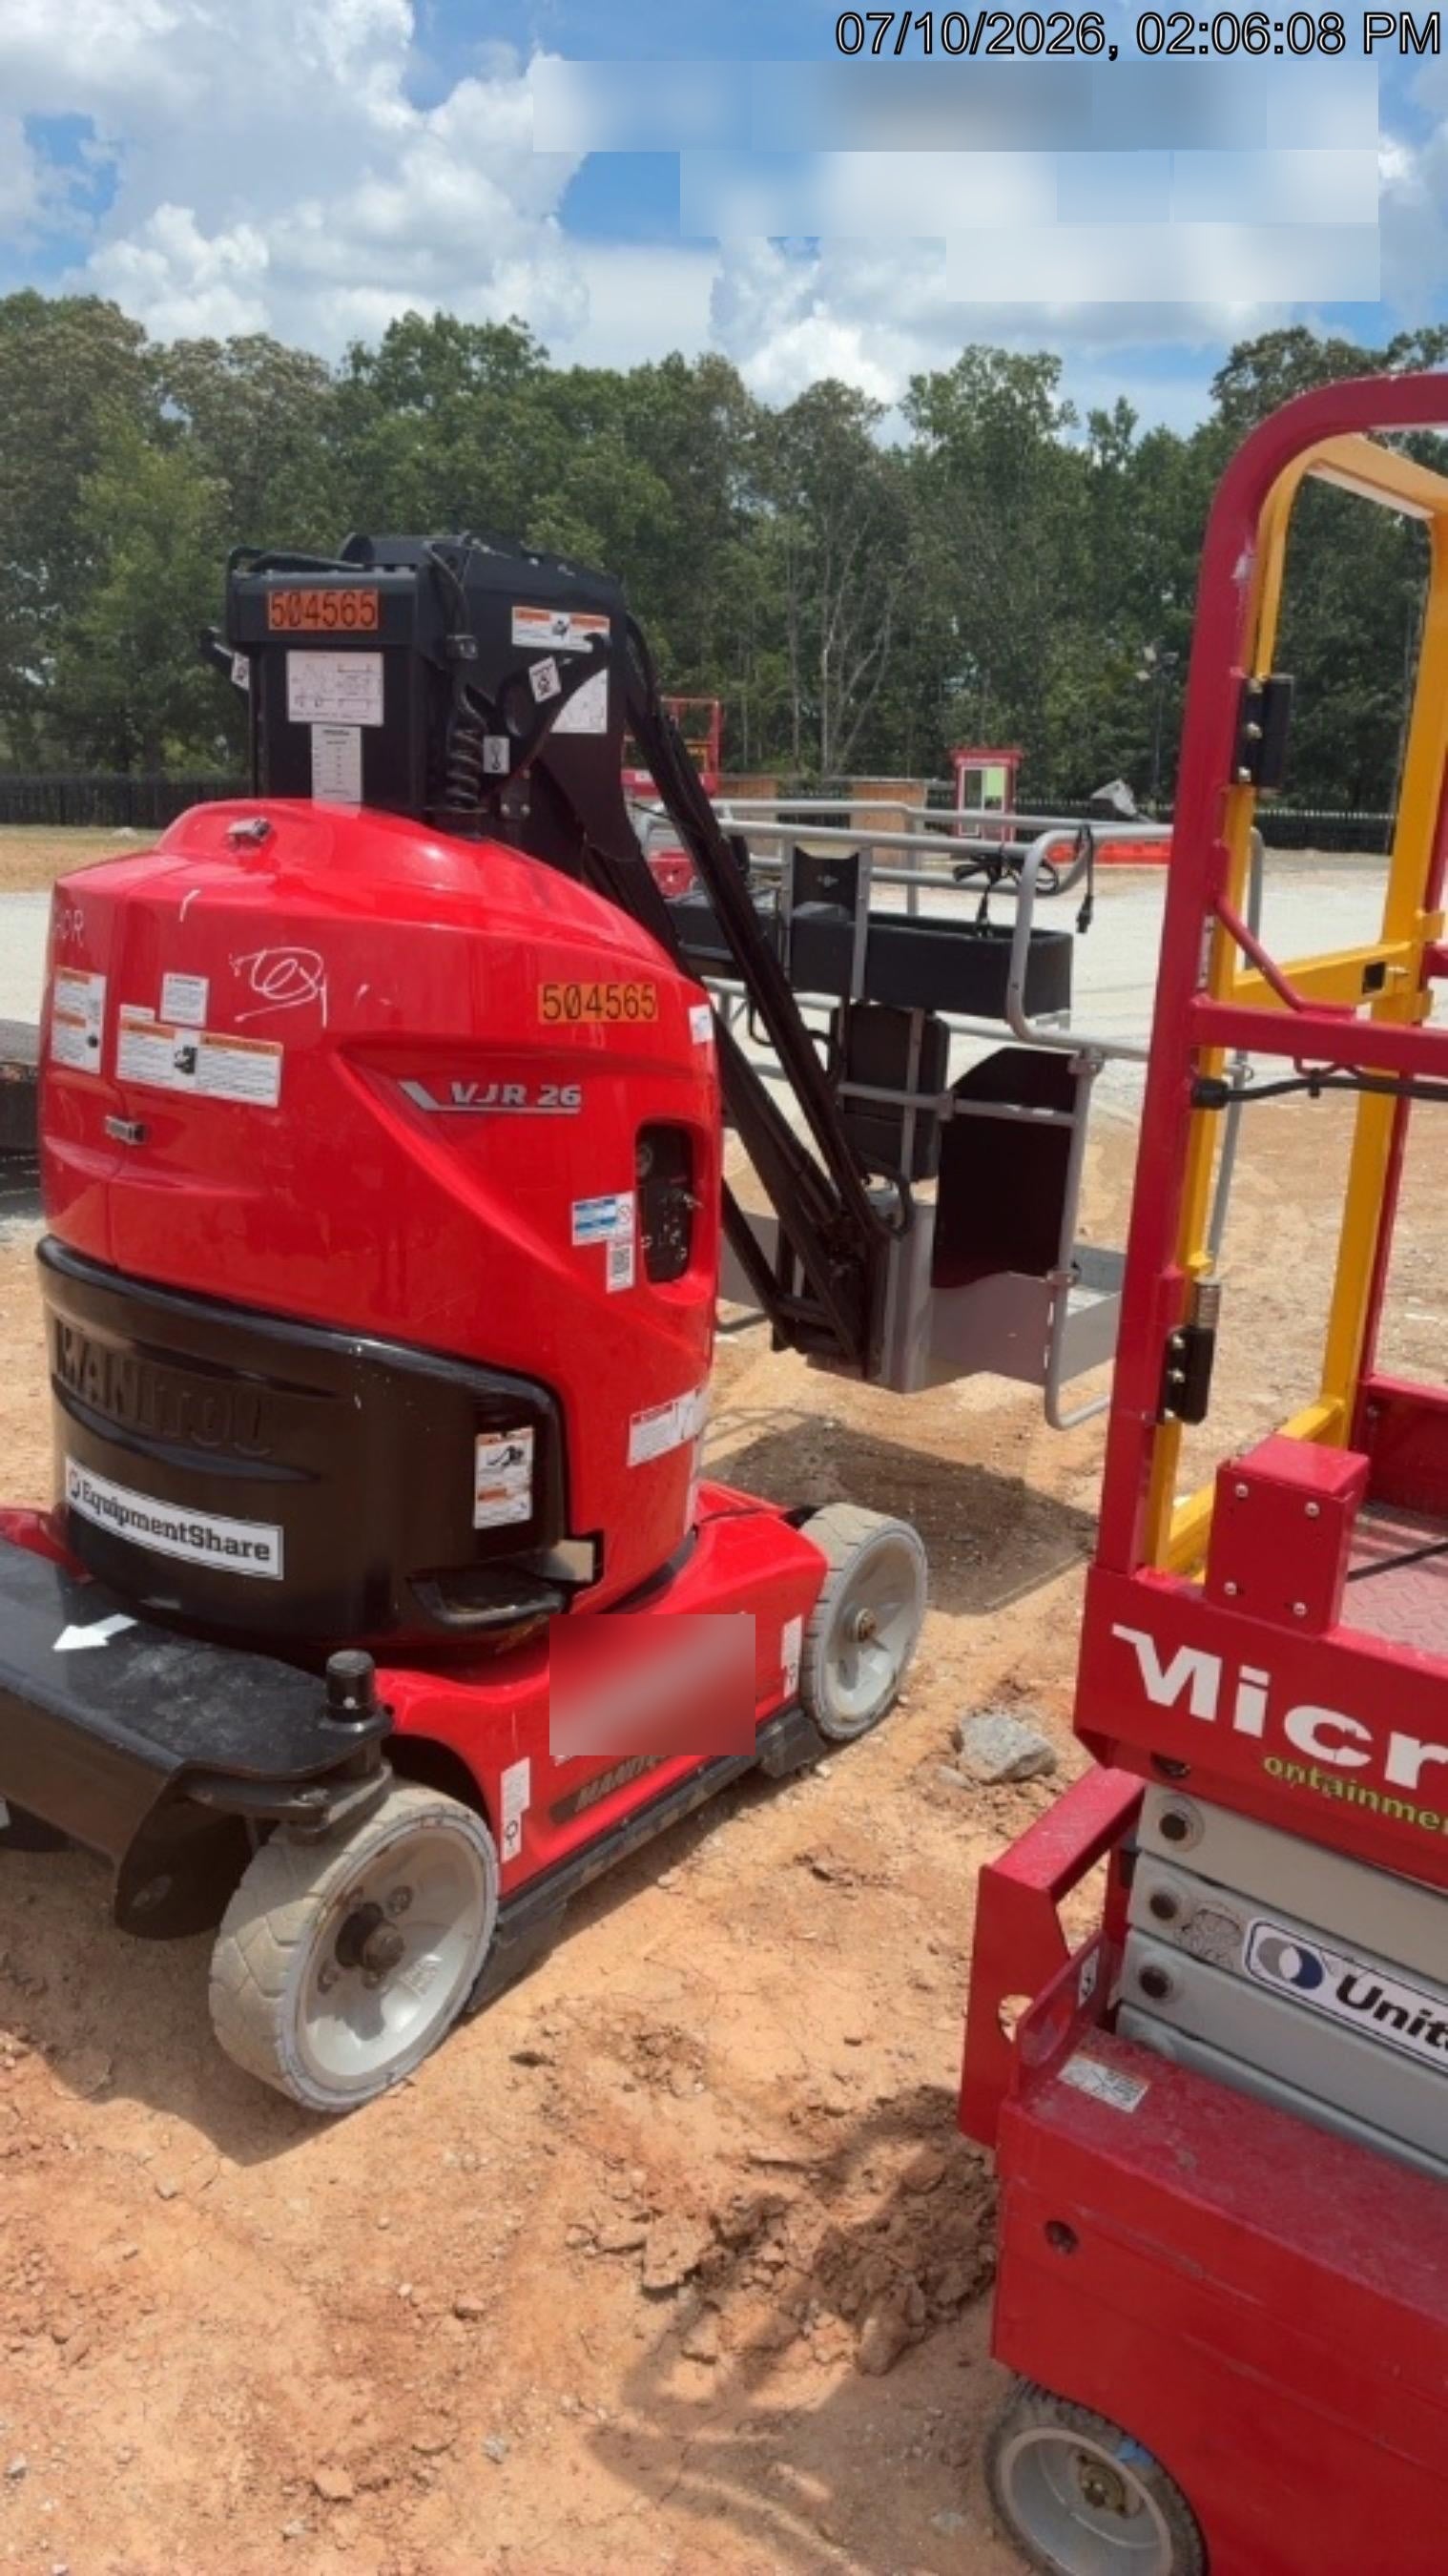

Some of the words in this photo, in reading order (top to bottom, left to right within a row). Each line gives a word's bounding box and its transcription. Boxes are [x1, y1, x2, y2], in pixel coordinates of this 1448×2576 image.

[270, 590, 377, 629] 504565
[542, 984, 656, 1020] 504565
[450, 1081, 527, 1106] VJR
[537, 1084, 582, 1108] 26
[82, 1479, 271, 1561] EquipmentShare
[1335, 1974, 1448, 2051] Unit
